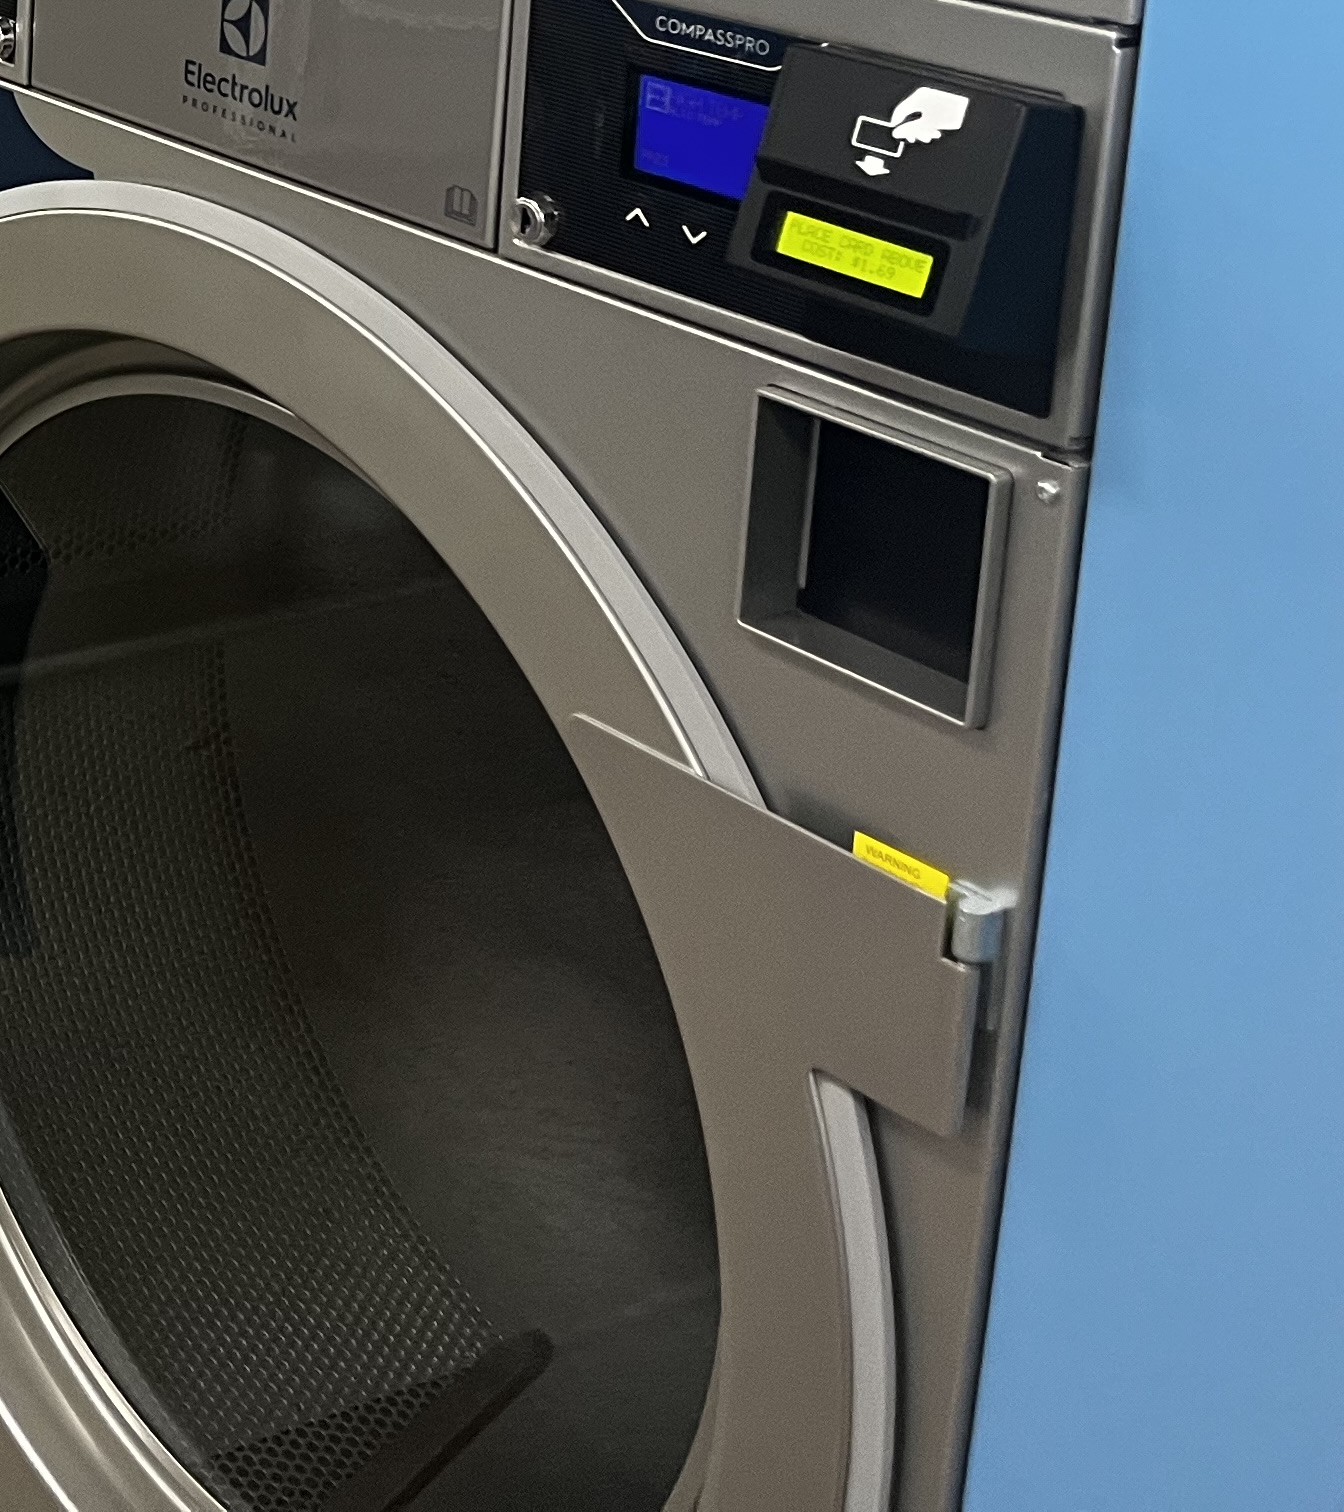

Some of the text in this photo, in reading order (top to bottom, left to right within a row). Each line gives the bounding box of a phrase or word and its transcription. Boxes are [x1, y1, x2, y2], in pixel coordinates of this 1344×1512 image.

[654, 15, 771, 56] COMPASSPRO
[183, 58, 299, 122] Electrolux
[182, 94, 297, 143] PROFESSIONAL
[864, 843, 922, 881] WARNING
